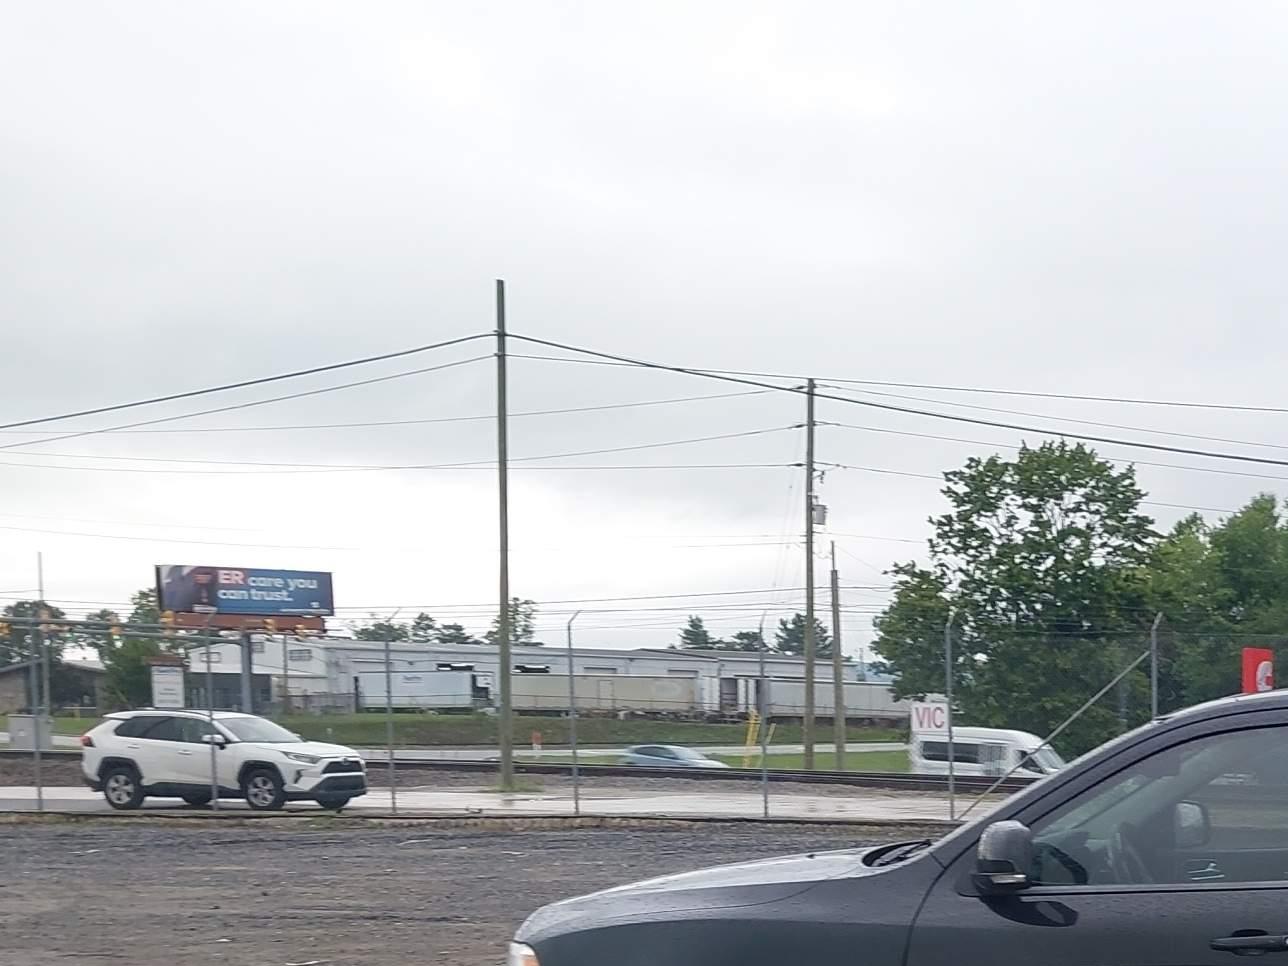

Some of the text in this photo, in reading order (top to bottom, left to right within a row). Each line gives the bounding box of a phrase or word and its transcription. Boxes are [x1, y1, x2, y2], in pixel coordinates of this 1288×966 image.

[217, 570, 318, 591] ER care you
[217, 588, 294, 602] can trust.
[914, 706, 945, 729] VIC
